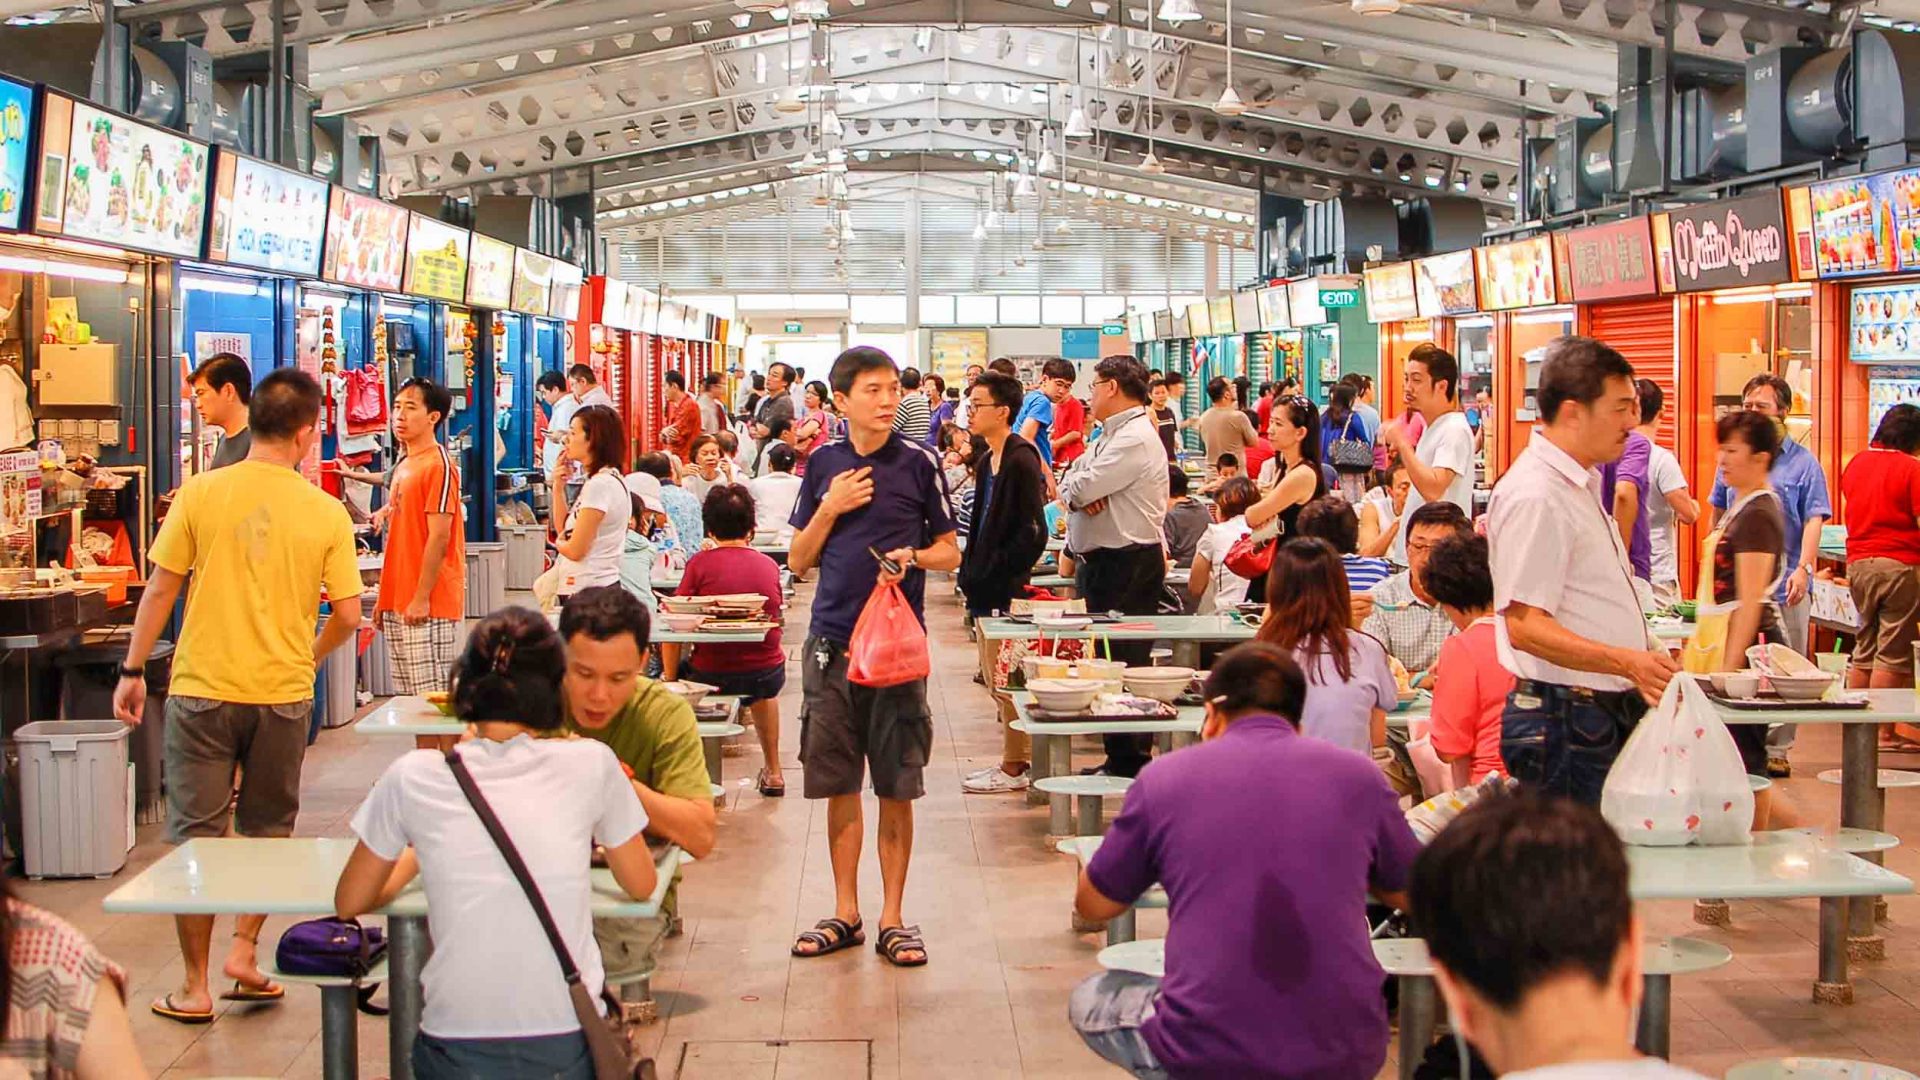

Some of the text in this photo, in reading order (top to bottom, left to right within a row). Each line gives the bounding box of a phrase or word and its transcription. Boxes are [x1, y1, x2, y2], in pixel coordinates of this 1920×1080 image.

[1674, 218, 1728, 280] Muffin
[1726, 209, 1780, 277] Queen
[1326, 291, 1351, 305] EXIT
